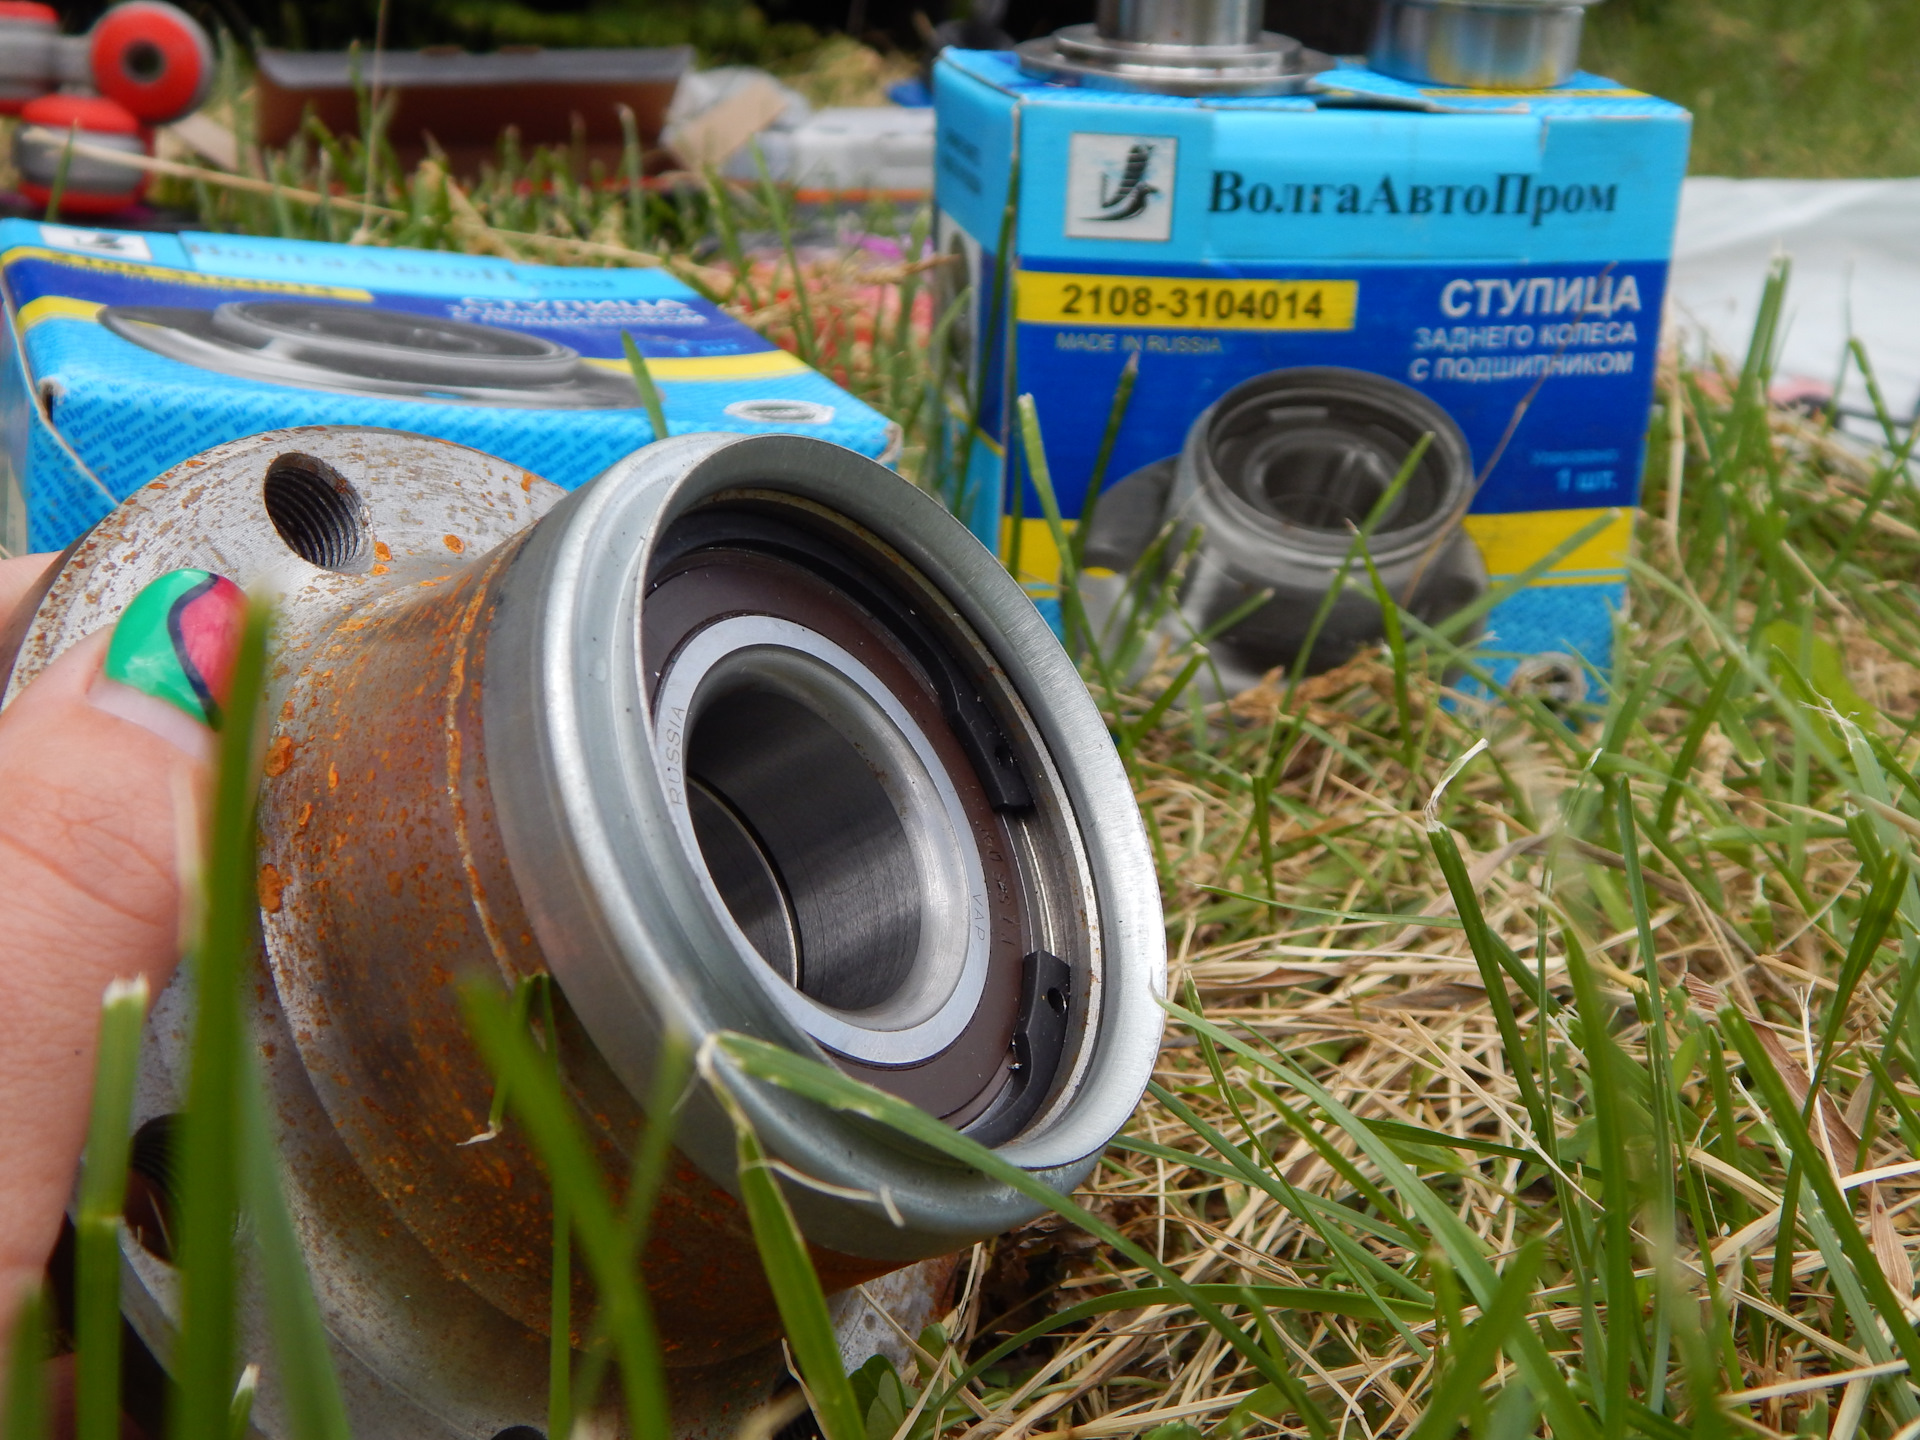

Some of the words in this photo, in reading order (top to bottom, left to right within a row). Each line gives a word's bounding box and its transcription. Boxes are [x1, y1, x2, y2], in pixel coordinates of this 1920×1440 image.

[1207, 170, 1618, 226] ВолгаАвтоПром
[1060, 284, 1323, 319] 2108-3104014
[1441, 275, 1641, 318] СТУПИЦА
[1056, 332, 1116, 351] MADE
[1121, 335, 1142, 352] IN
[1147, 336, 1223, 354] RUSSIA
[1414, 324, 1534, 352] ЗАДНЕГО
[1538, 321, 1637, 345] КОЛЕСА
[1408, 357, 1430, 382] С
[1433, 351, 1635, 383] ПОДШИПНИКОМ
[665, 706, 685, 806] RUSSIA
[972, 893, 986, 941] VAP
